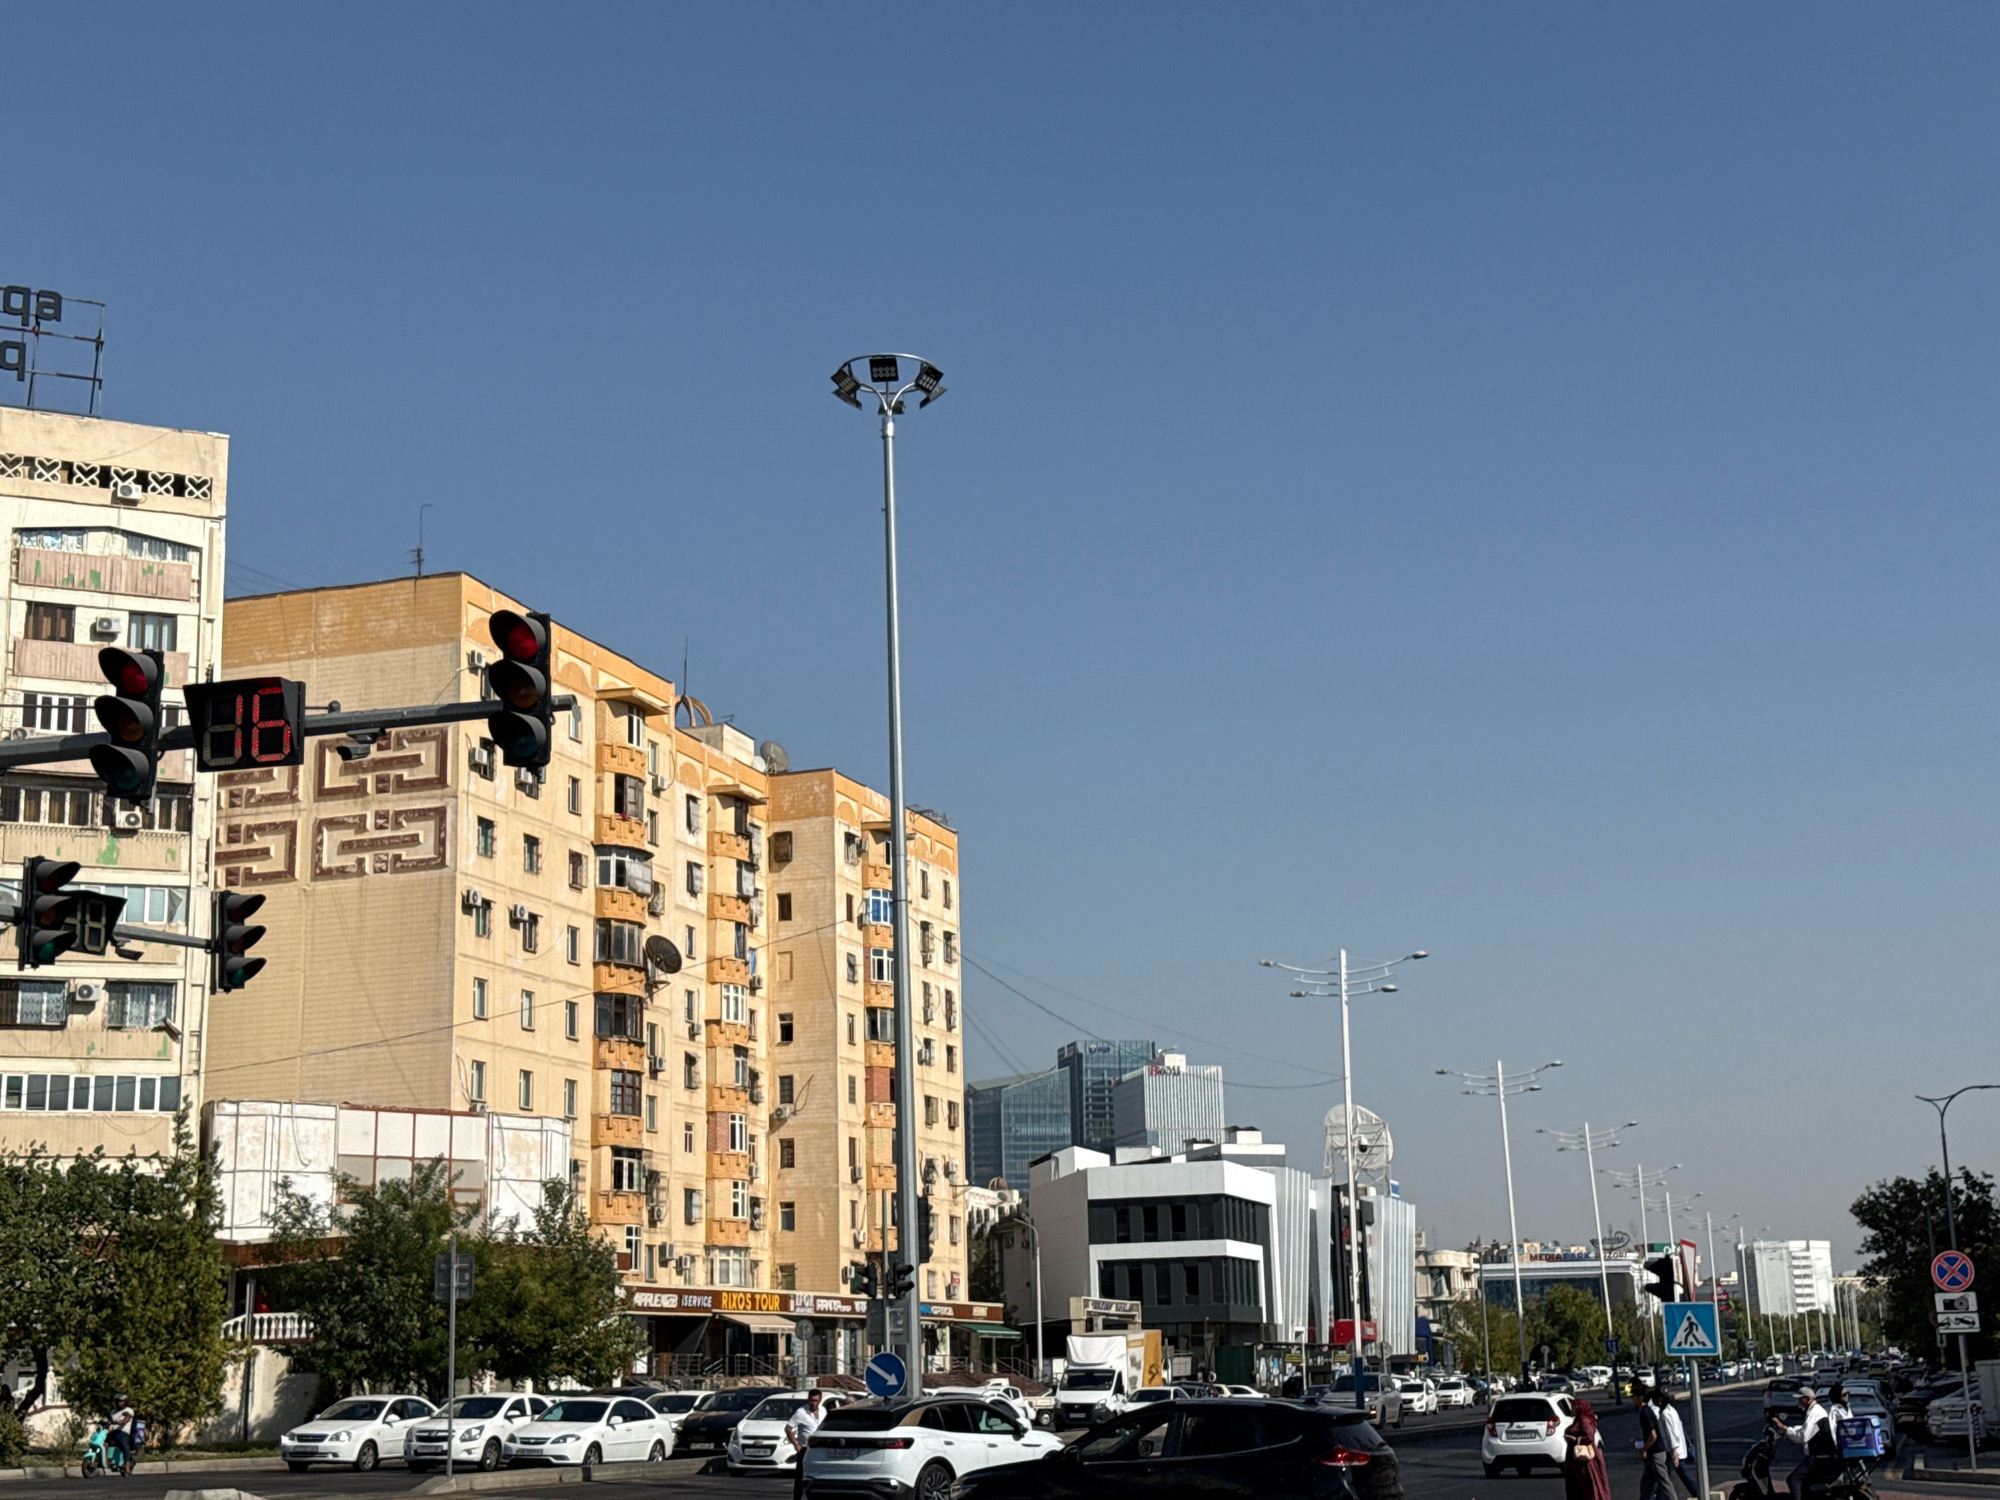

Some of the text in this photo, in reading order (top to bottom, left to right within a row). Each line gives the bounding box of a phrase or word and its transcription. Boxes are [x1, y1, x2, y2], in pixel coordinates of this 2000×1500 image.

[234, 686, 292, 763] 16
[721, 1292, 752, 1310] RIXOS
[754, 1294, 780, 1311] TOUR
